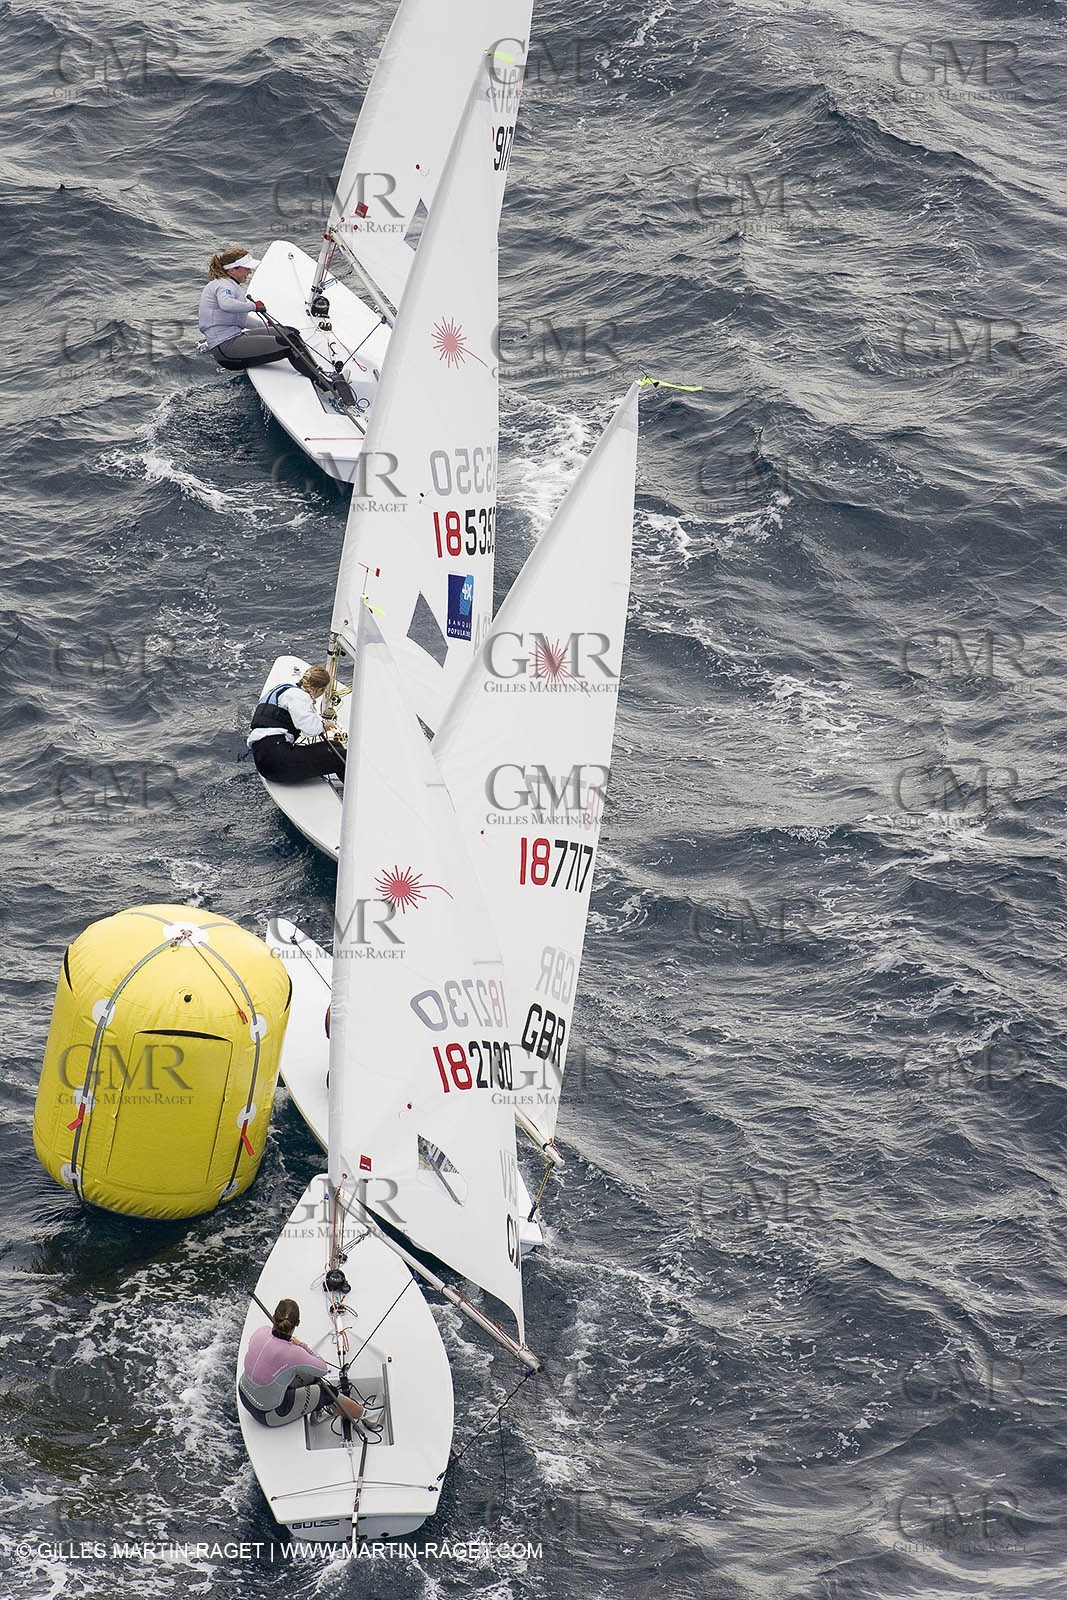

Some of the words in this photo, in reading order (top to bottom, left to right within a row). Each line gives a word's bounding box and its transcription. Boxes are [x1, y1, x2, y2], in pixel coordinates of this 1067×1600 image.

[519, 837, 593, 893] 187717
[521, 1003, 565, 1067] GBR
[432, 1040, 513, 1093] 182730
